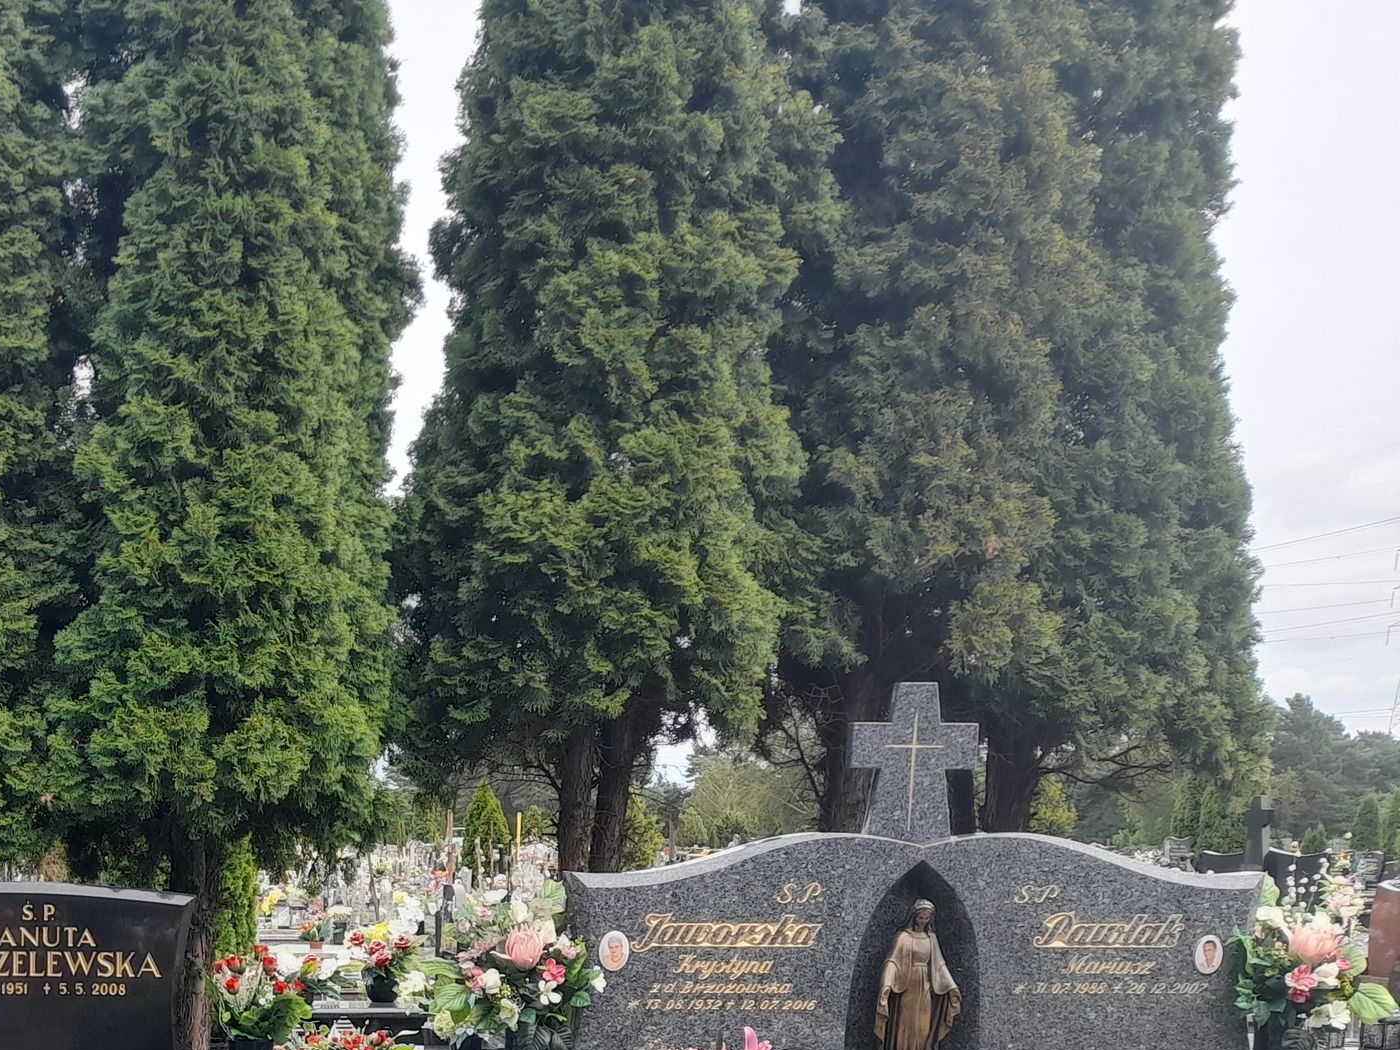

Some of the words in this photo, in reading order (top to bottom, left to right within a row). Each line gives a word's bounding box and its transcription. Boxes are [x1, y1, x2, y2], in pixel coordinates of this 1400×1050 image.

[630, 911, 825, 953] Jaworska
[1033, 911, 1186, 948] Pawlak
[672, 953, 775, 981] Krystyna
[1063, 954, 1157, 975] Mariusz
